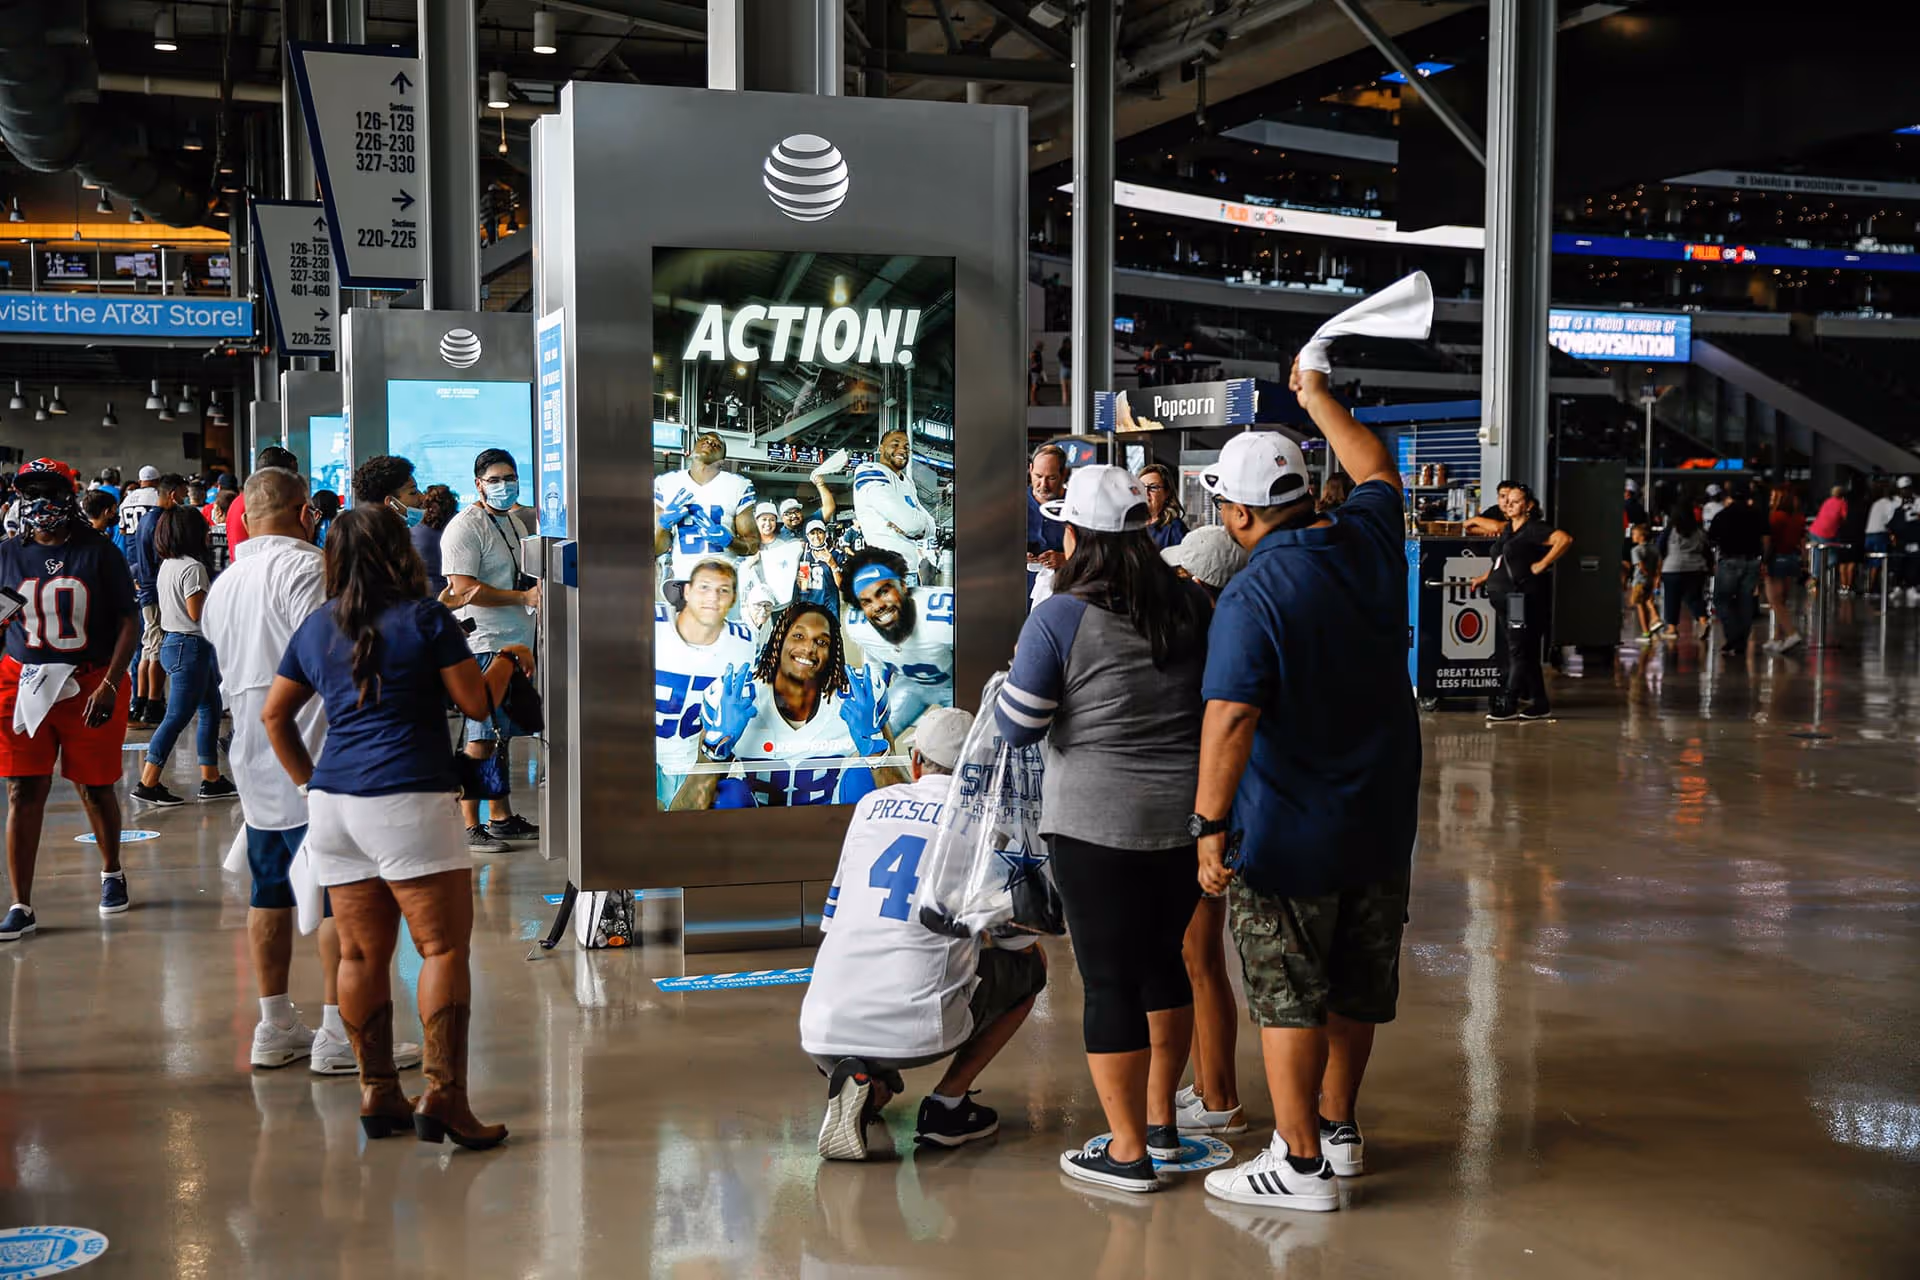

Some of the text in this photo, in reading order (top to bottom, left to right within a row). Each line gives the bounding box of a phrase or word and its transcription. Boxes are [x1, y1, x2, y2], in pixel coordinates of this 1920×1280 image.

[356, 111, 414, 132] 126-129
[355, 132, 415, 152] 226-230
[356, 153, 415, 173] 327-330
[358, 229, 416, 248] 220-225
[0, 299, 243, 327] visit the AT&T Store!
[682, 304, 921, 365] ACTION!
[1154, 395, 1215, 421] Popcorn
[17, 576, 90, 652] 10
[1437, 667, 1501, 678] GREAT TASTE.
[1436, 678, 1501, 689] LESS FILLING.
[869, 834, 929, 922] 4
